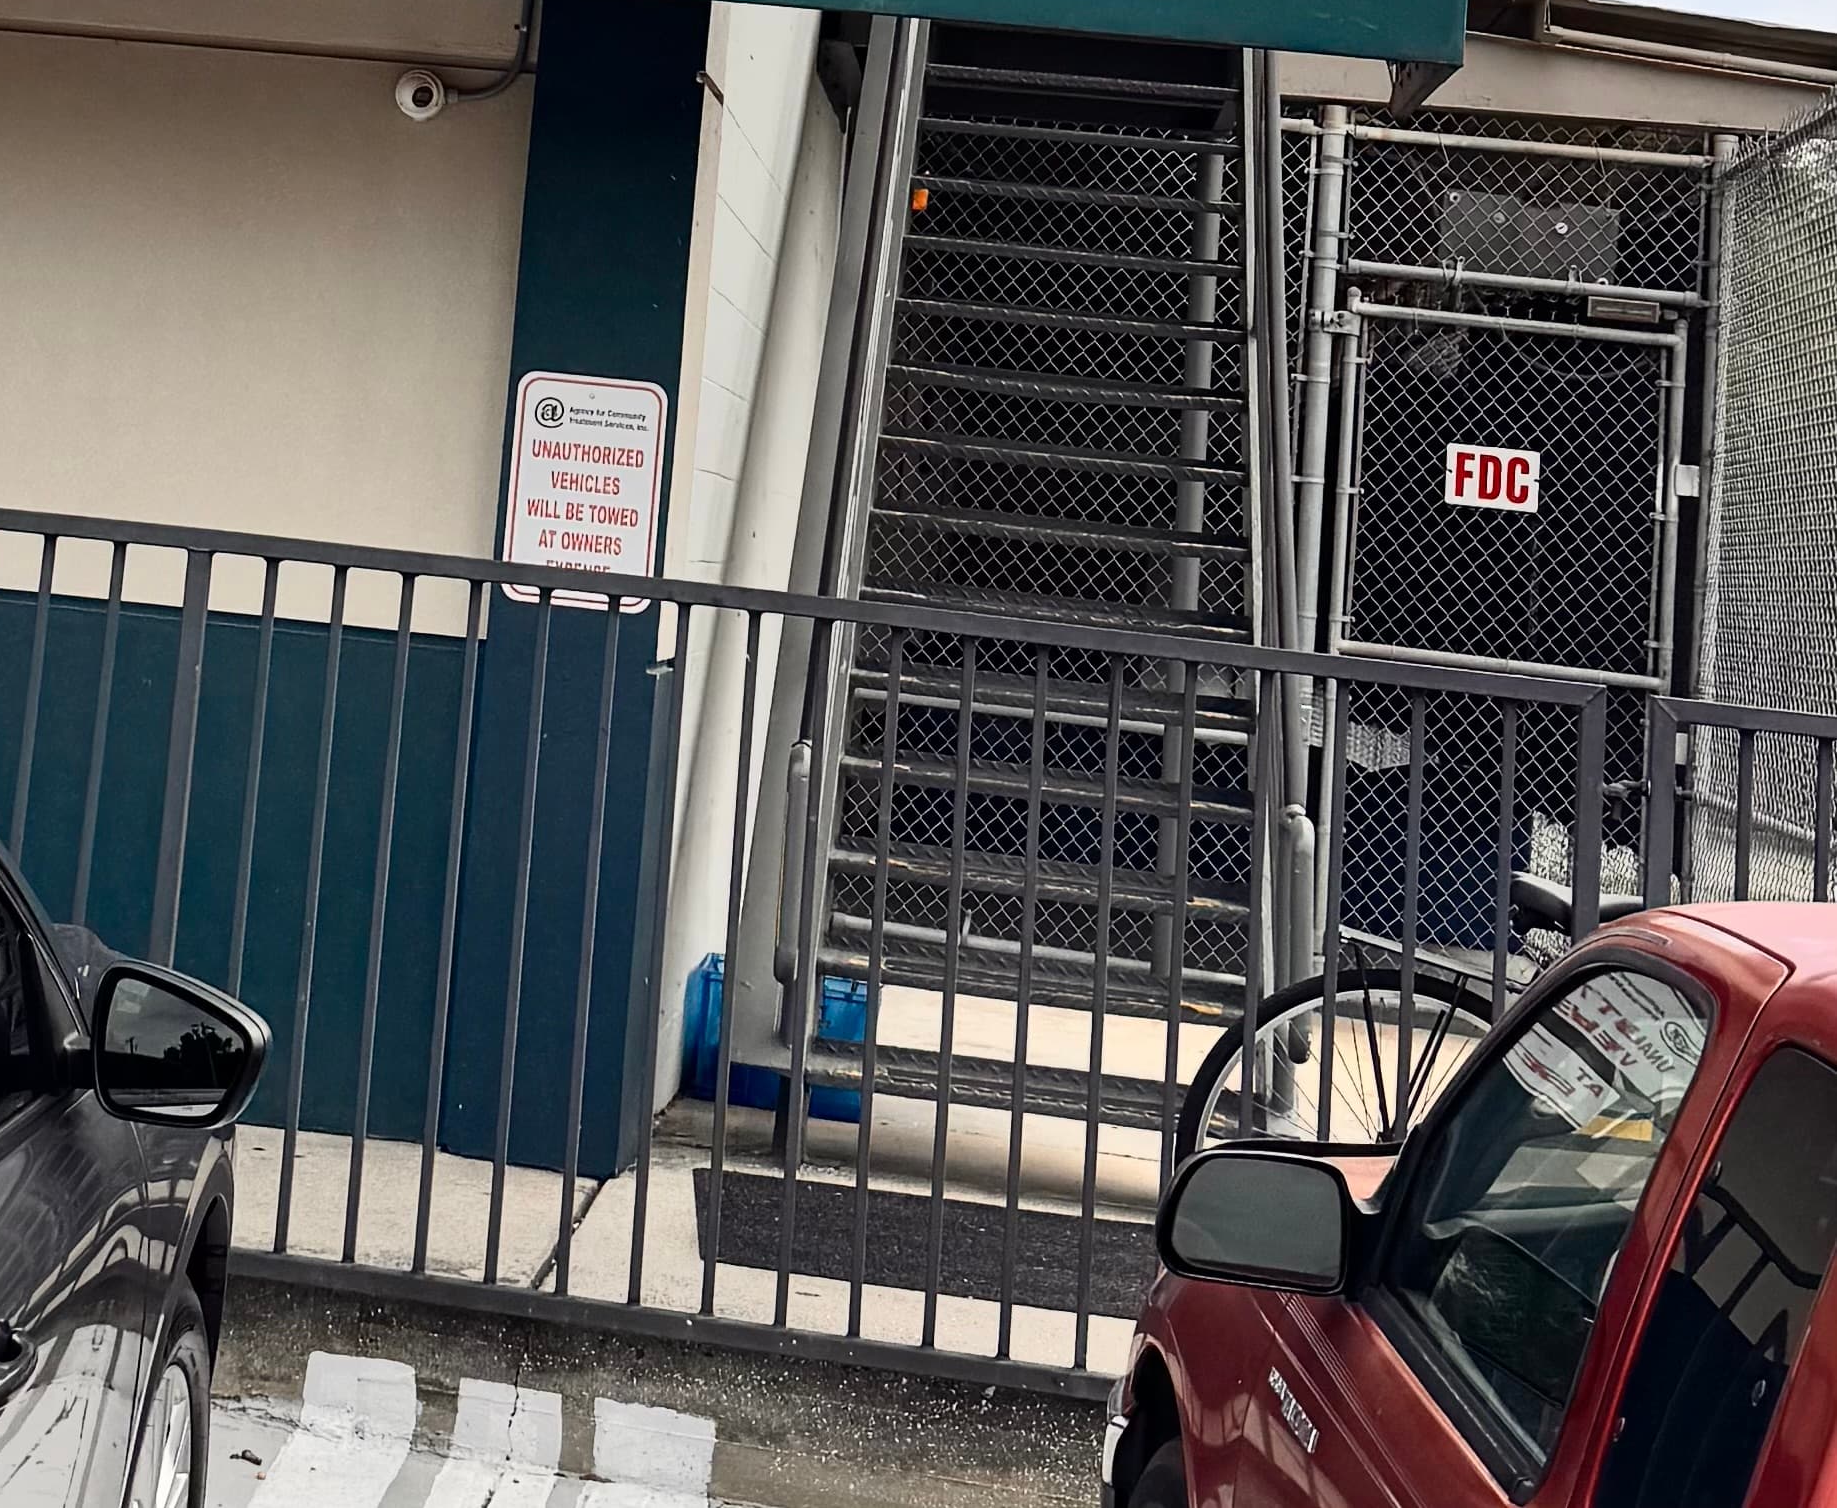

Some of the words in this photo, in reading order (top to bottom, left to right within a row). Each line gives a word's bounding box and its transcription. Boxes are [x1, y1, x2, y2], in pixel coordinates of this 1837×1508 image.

[531, 439, 644, 468] UNAUTHORIZED
[551, 470, 621, 495] VEHICLES
[1454, 451, 1530, 504] FDC
[526, 498, 561, 520] WILL
[565, 502, 584, 522] BE
[588, 503, 639, 528] TOWED
[538, 529, 557, 549] AT
[561, 530, 622, 556] OWNERS
